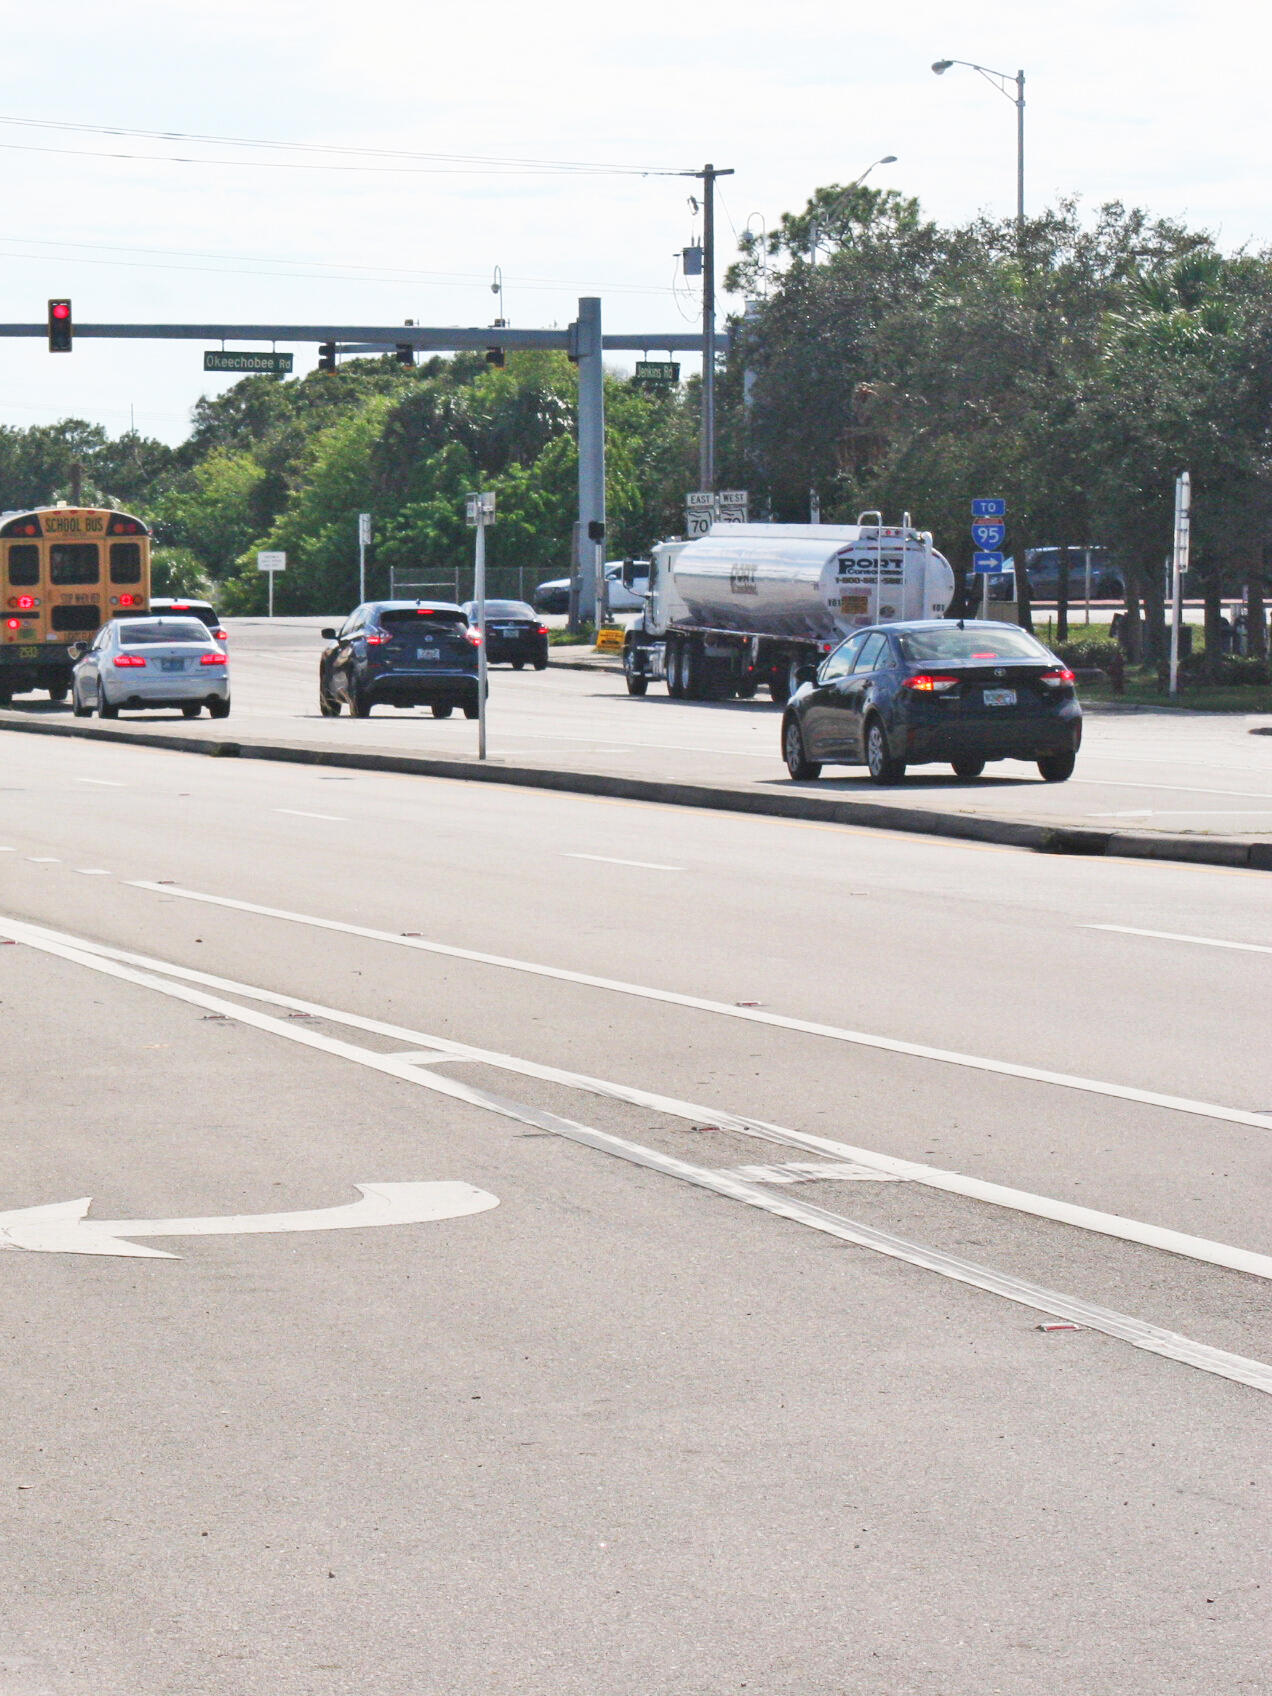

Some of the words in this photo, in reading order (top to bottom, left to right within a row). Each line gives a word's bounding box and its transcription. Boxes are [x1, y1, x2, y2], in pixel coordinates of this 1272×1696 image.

[207, 355, 274, 369] Okeechobee
[279, 359, 291, 369] Rd
[691, 495, 710, 504] EAST
[723, 494, 743, 503] WEST
[980, 502, 996, 512] TO
[45, 517, 81, 533] SCHOOL
[85, 517, 104, 532] BUS
[691, 520, 708, 533] 70
[978, 527, 999, 543] 95
[839, 558, 903, 575] PORT
